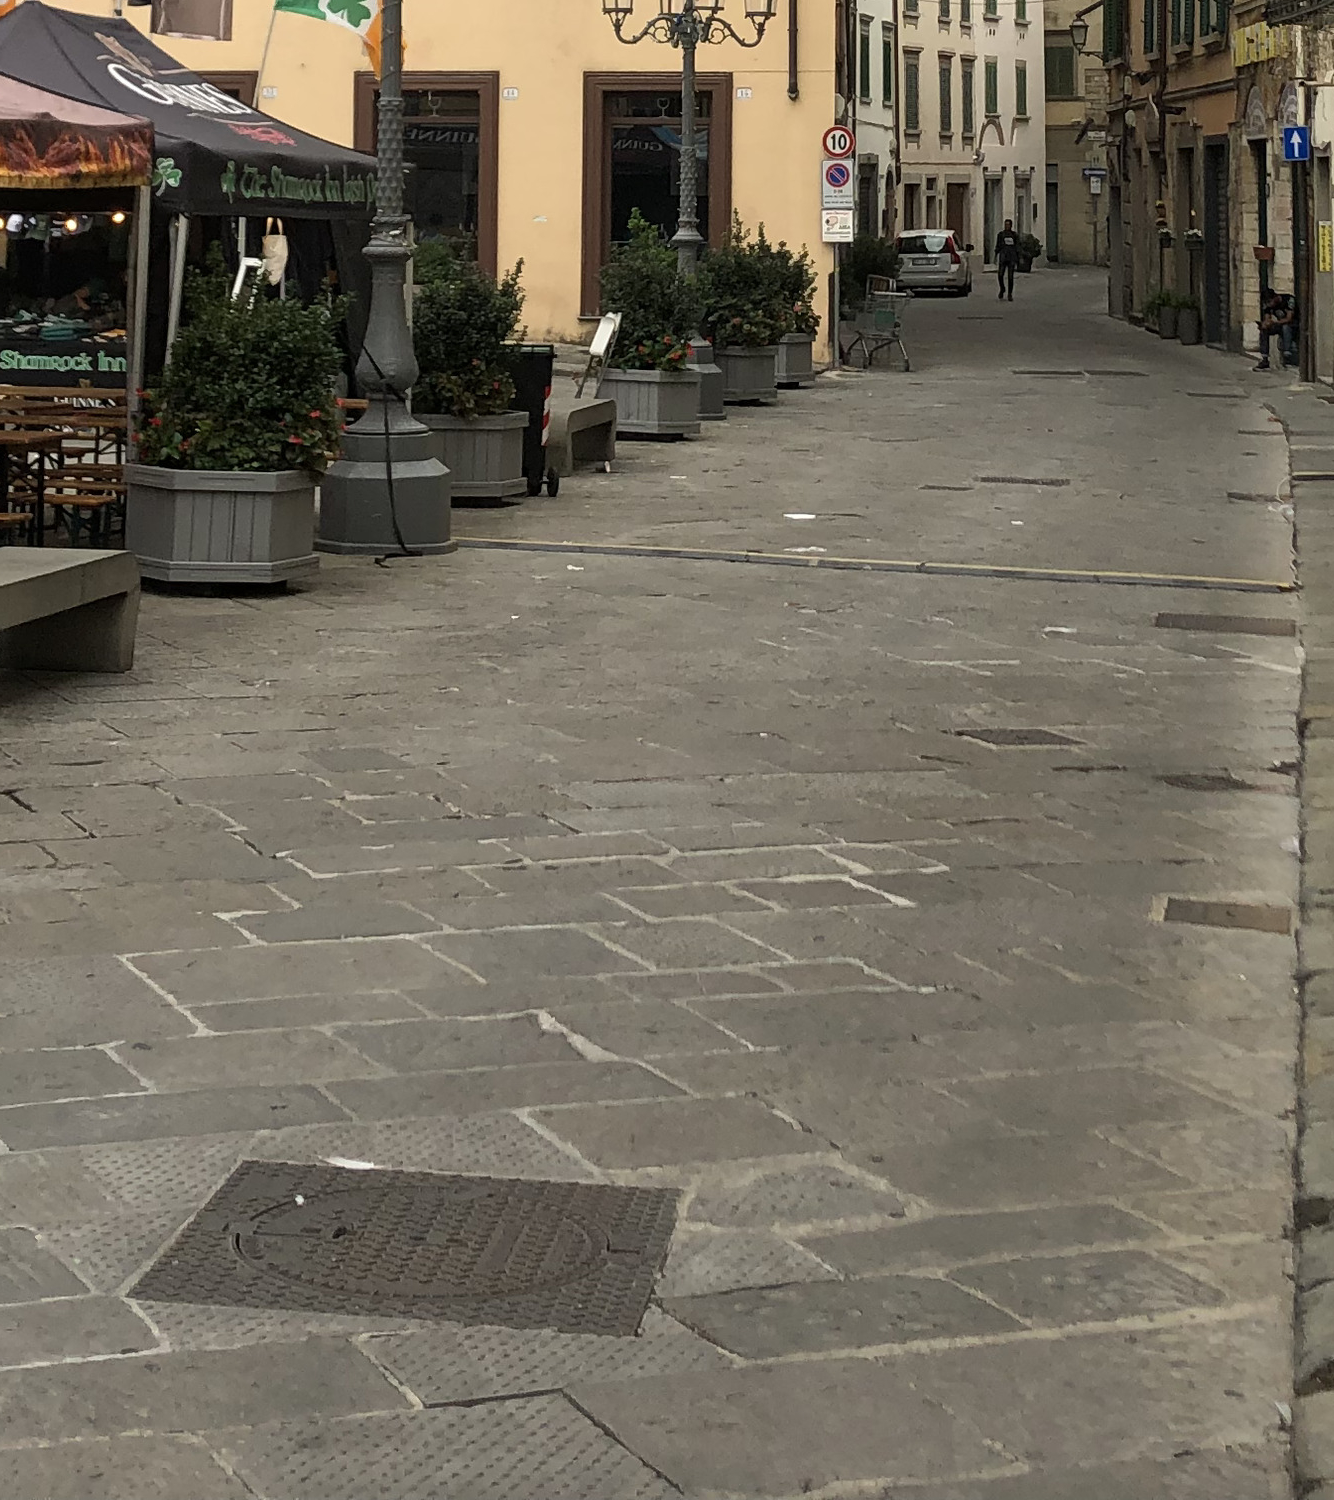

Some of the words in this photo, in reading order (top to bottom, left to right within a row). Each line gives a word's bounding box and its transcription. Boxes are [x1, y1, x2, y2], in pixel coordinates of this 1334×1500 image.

[830, 133, 848, 151] 10
[0, 349, 94, 372] Shamrock
[97, 349, 128, 372] Inn
